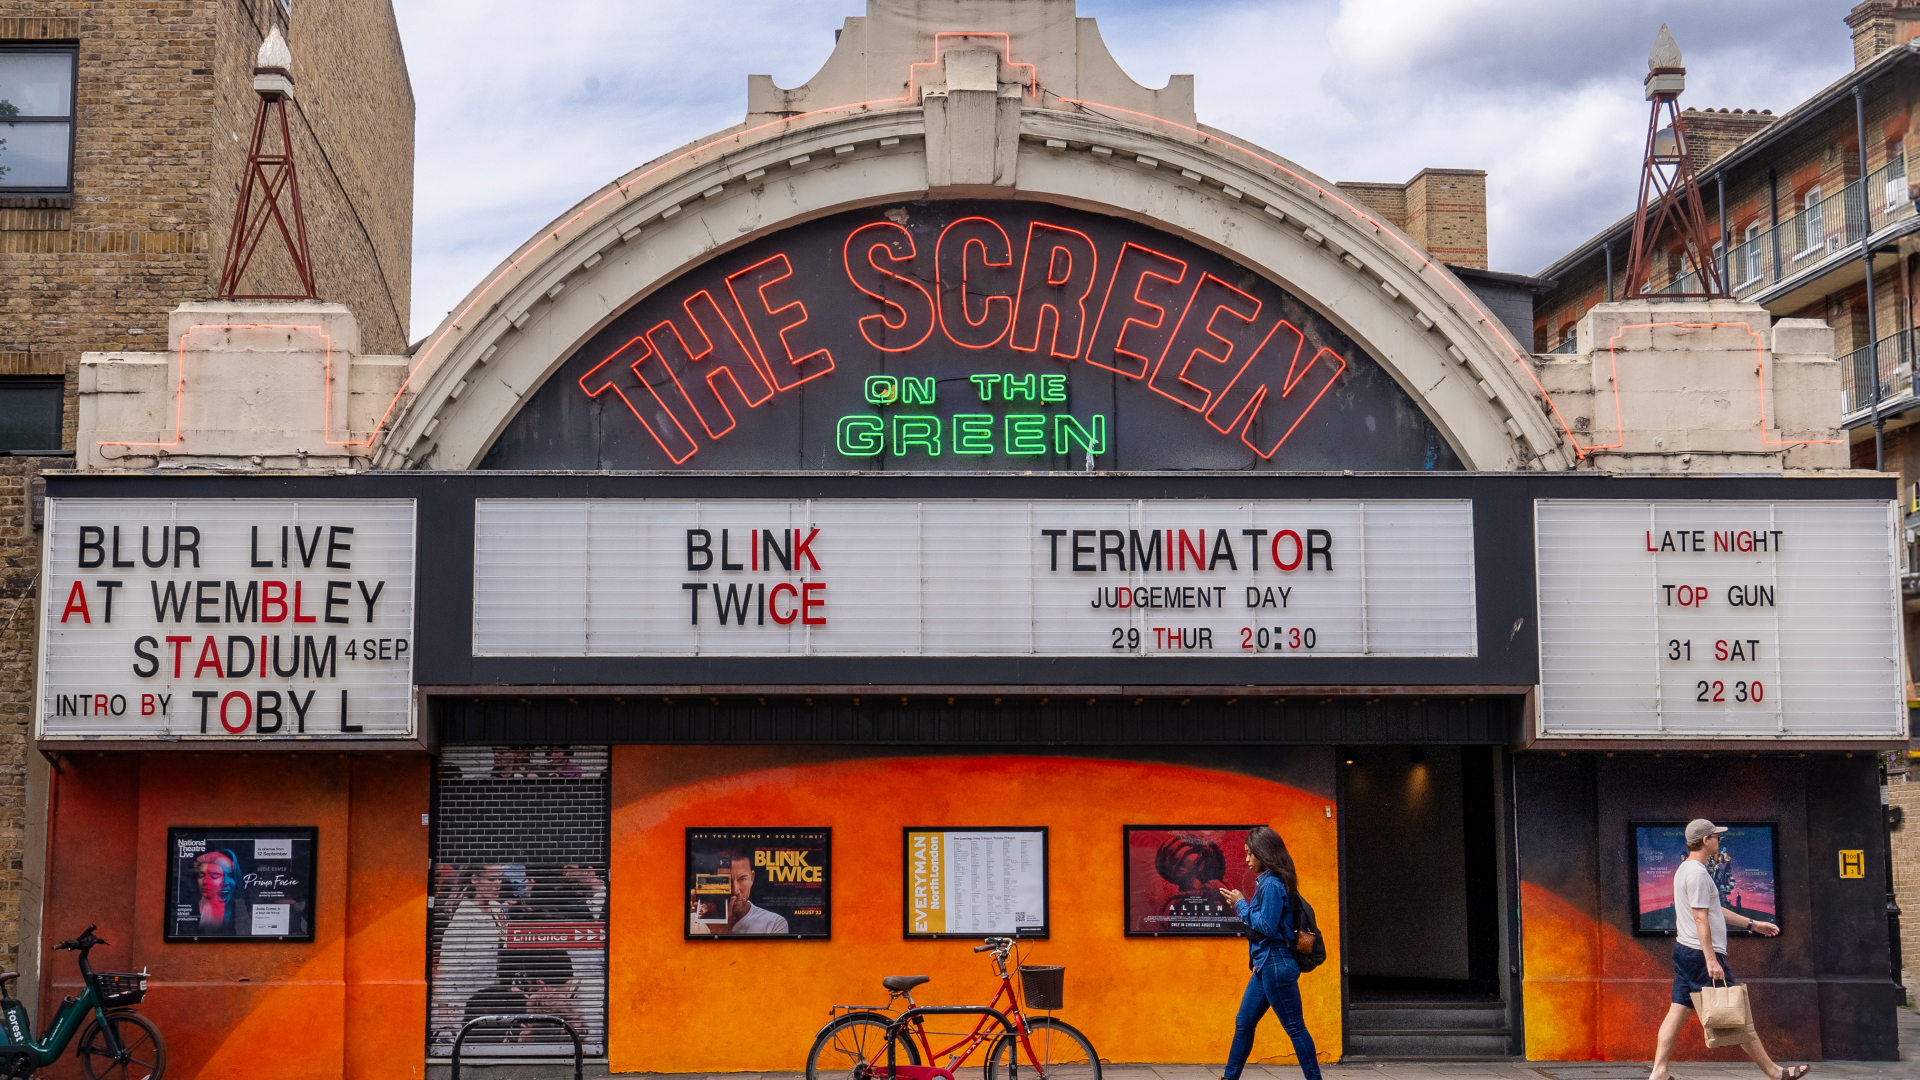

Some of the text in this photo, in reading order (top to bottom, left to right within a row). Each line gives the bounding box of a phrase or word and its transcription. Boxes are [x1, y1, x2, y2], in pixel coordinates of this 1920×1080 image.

[578, 215, 1347, 464] THE SCREEN
[864, 374, 1067, 405] ON THE
[836, 413, 1106, 457] GREEN
[78, 525, 355, 569] BLUR LIVE
[686, 527, 822, 572] BLINK
[1041, 528, 1334, 572] TERMINATOR
[1646, 530, 1783, 553] LATE NIGHT
[60, 580, 386, 624] AT WEMBLEY
[681, 582, 827, 626] TWICE
[1091, 586, 1292, 609] JUDGEMENT DAY
[1662, 584, 1775, 608] TOP GUN
[1111, 626, 1317, 650] 29 THUR 20:30
[1668, 639, 1760, 662] 31 SAT
[132, 635, 409, 679] STADIUM 4 SEP
[1696, 680, 1764, 703] 22 30
[56, 689, 364, 734] INTRO BY TOBY L
[755, 850, 809, 866] BLINK
[1842, 852, 1860, 875] H
[243, 873, 272, 889] Prima
[766, 866, 822, 882] TWICE
[914, 836, 928, 932] EVERYMAN
[514, 930, 568, 942] Entrance
[8, 1010, 24, 1042] forest
